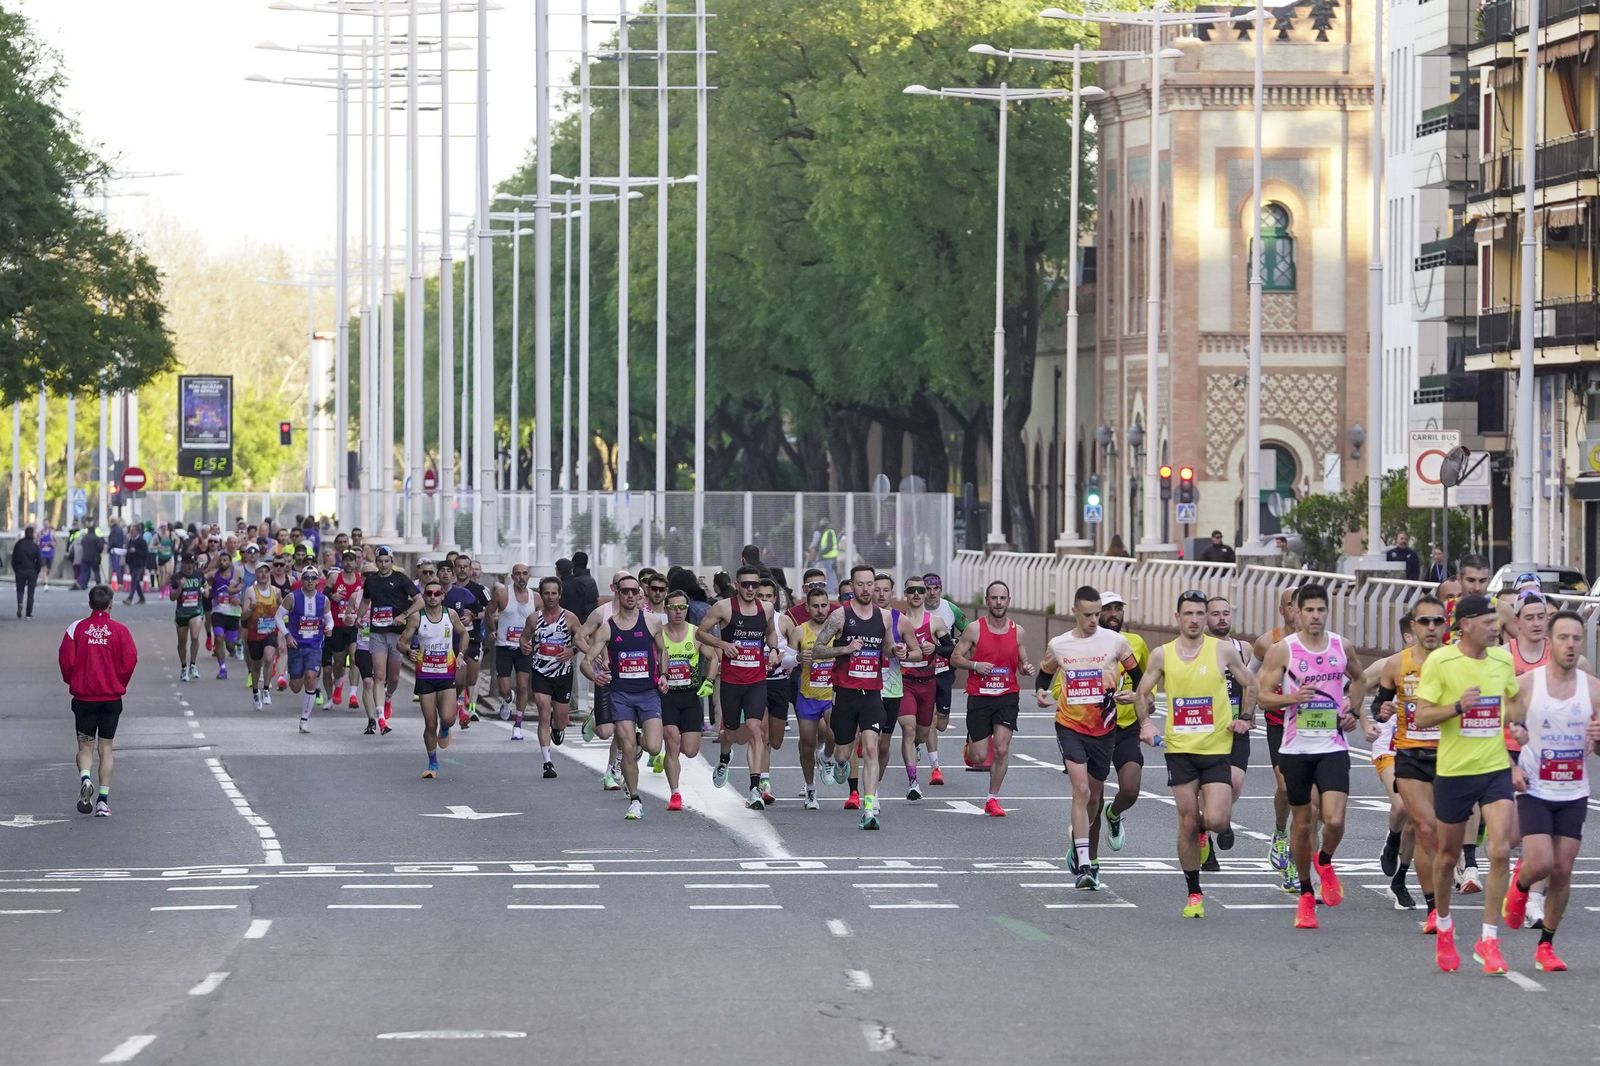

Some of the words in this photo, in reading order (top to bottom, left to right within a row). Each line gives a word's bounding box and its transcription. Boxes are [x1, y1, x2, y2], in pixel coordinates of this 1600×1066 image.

[193, 457, 227, 471] 8:52
[1068, 688, 1091, 697] MARIO
[1091, 687, 1102, 695] BL
[1184, 716, 1203, 725] MAX
[1306, 720, 1327, 728] FRAN
[1550, 771, 1574, 780] TOMZ
